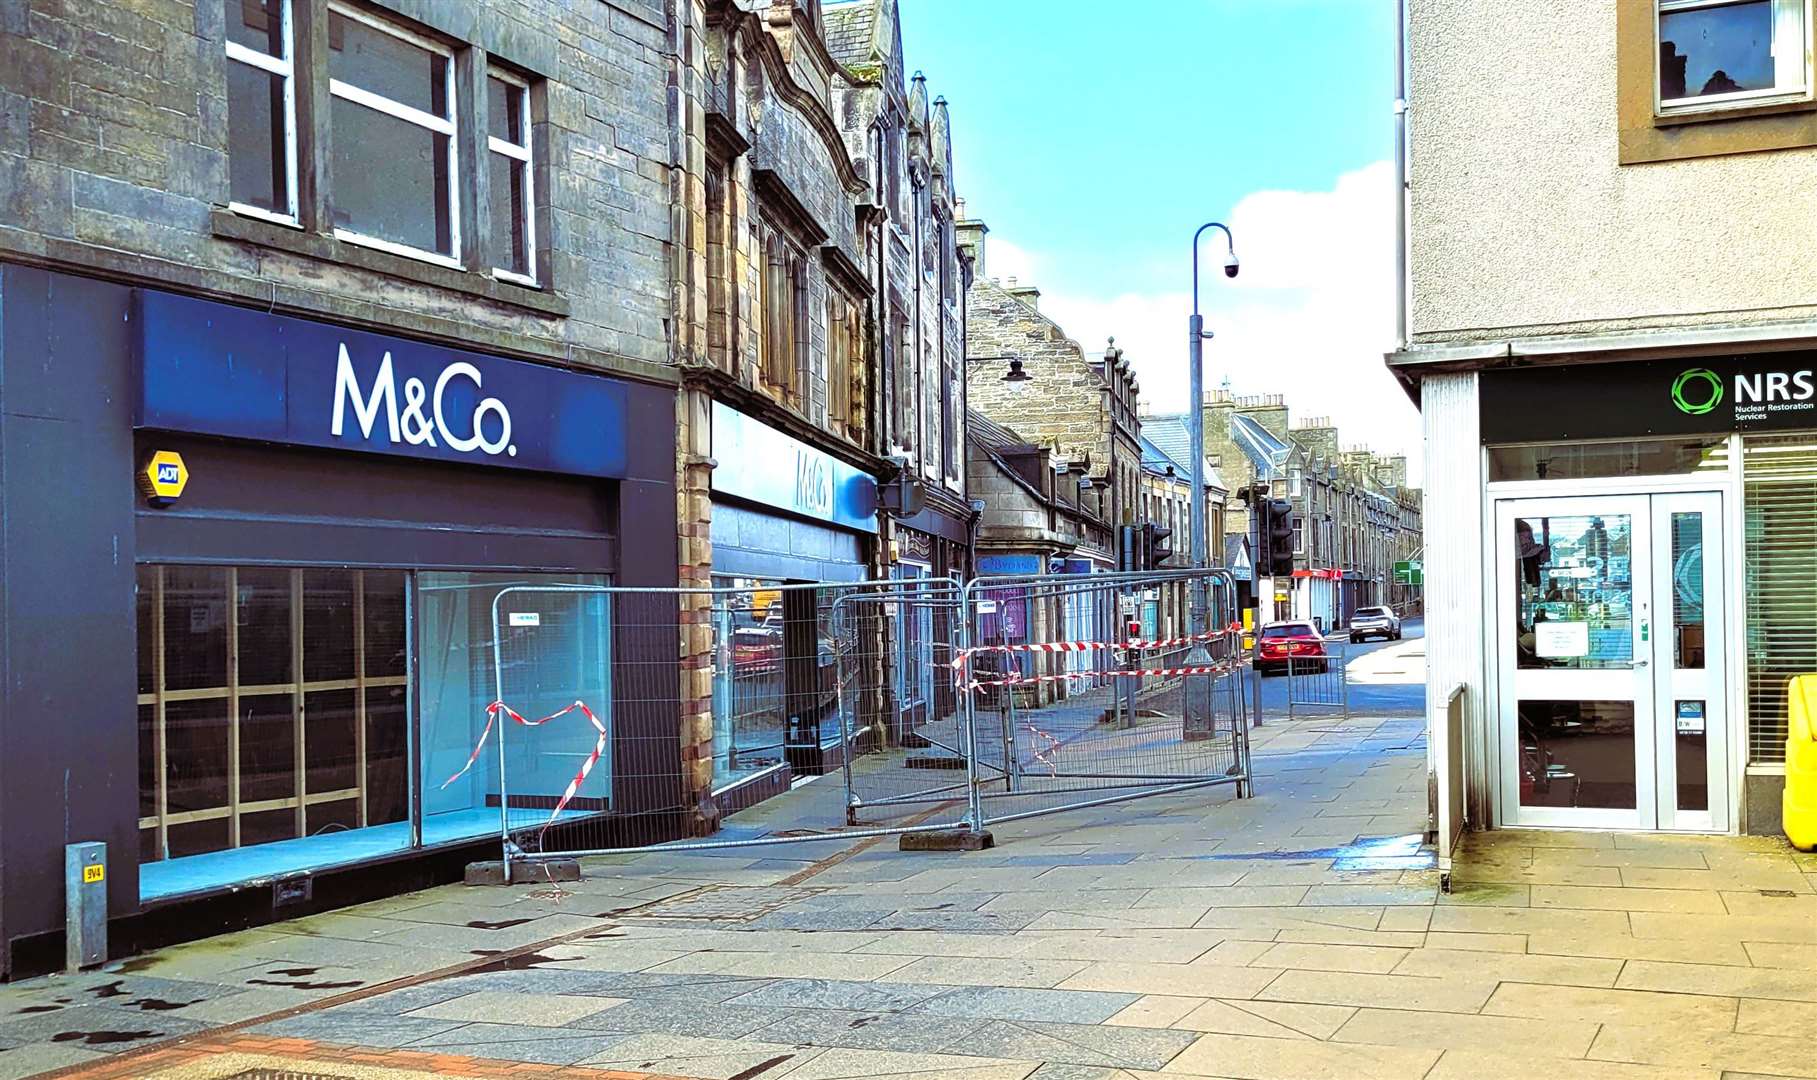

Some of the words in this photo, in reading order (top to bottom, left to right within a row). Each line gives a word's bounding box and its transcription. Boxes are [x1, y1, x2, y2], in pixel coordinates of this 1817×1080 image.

[1734, 370, 1815, 403] NRS
[331, 342, 517, 457] M&Co.
[1735, 405, 1766, 413] Nuclear
[1767, 402, 1814, 411] Restoration
[1735, 413, 1767, 421] Services
[158, 467, 178, 481] ADT
